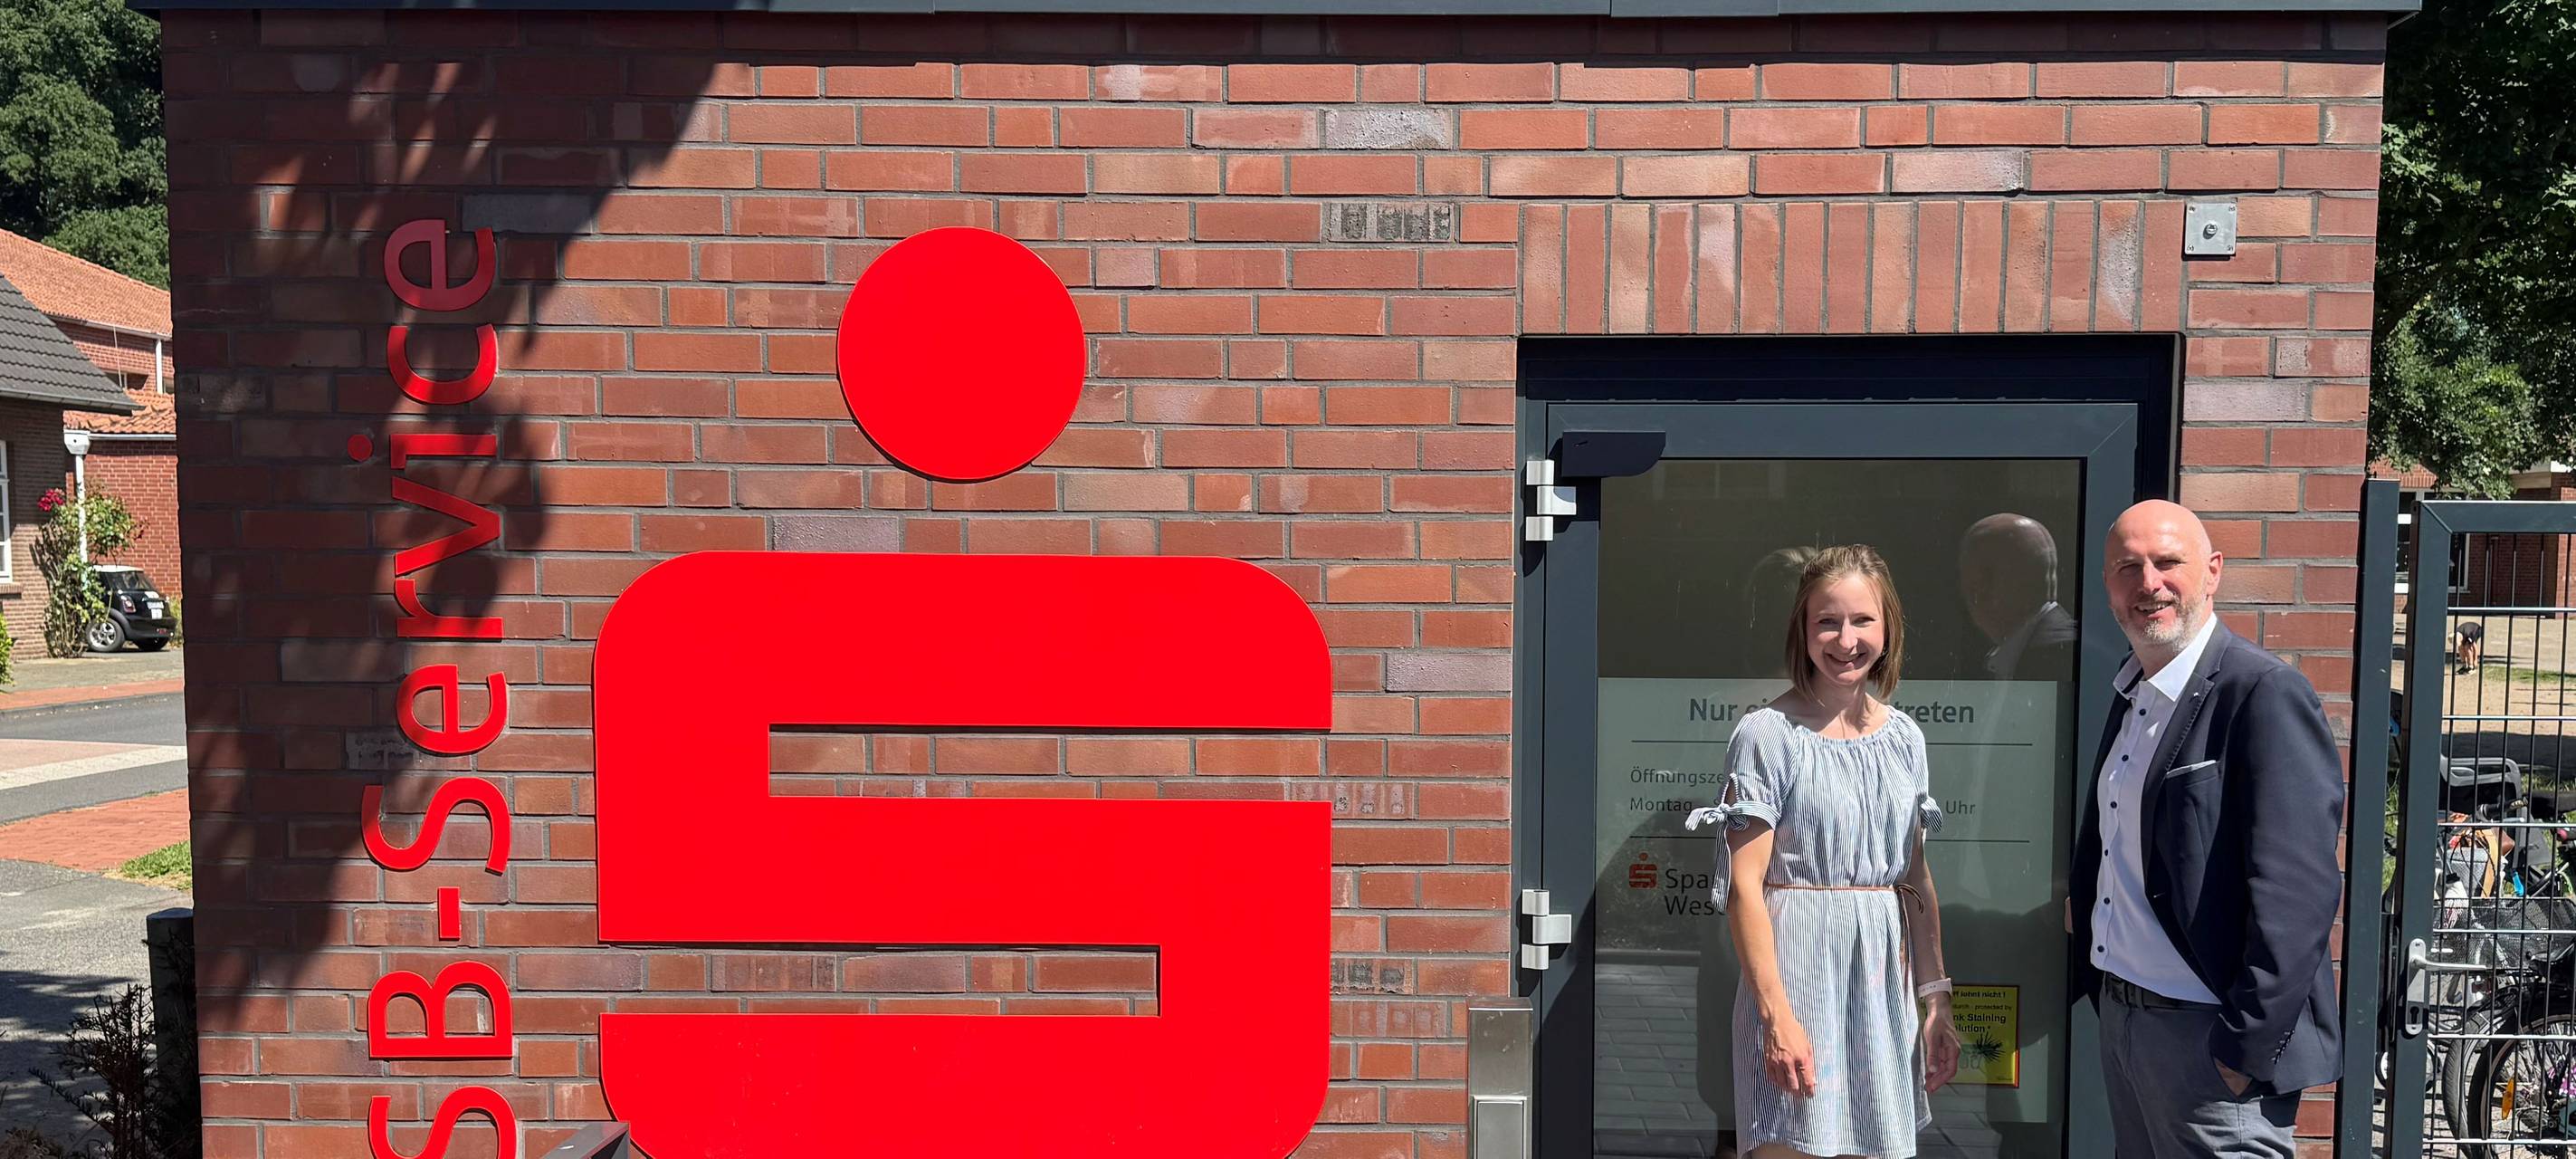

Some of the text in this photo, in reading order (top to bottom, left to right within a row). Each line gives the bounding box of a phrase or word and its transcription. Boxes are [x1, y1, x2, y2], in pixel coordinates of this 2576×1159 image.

[348, 218, 517, 1159] SB-Service
[1690, 698, 1737, 721] Nur
[1630, 766, 1724, 787] Öffnungsze
[1630, 798, 1692, 812] Montag
[1946, 800, 1976, 814] Uhr
[1953, 1013, 2007, 1024] nk Staining
